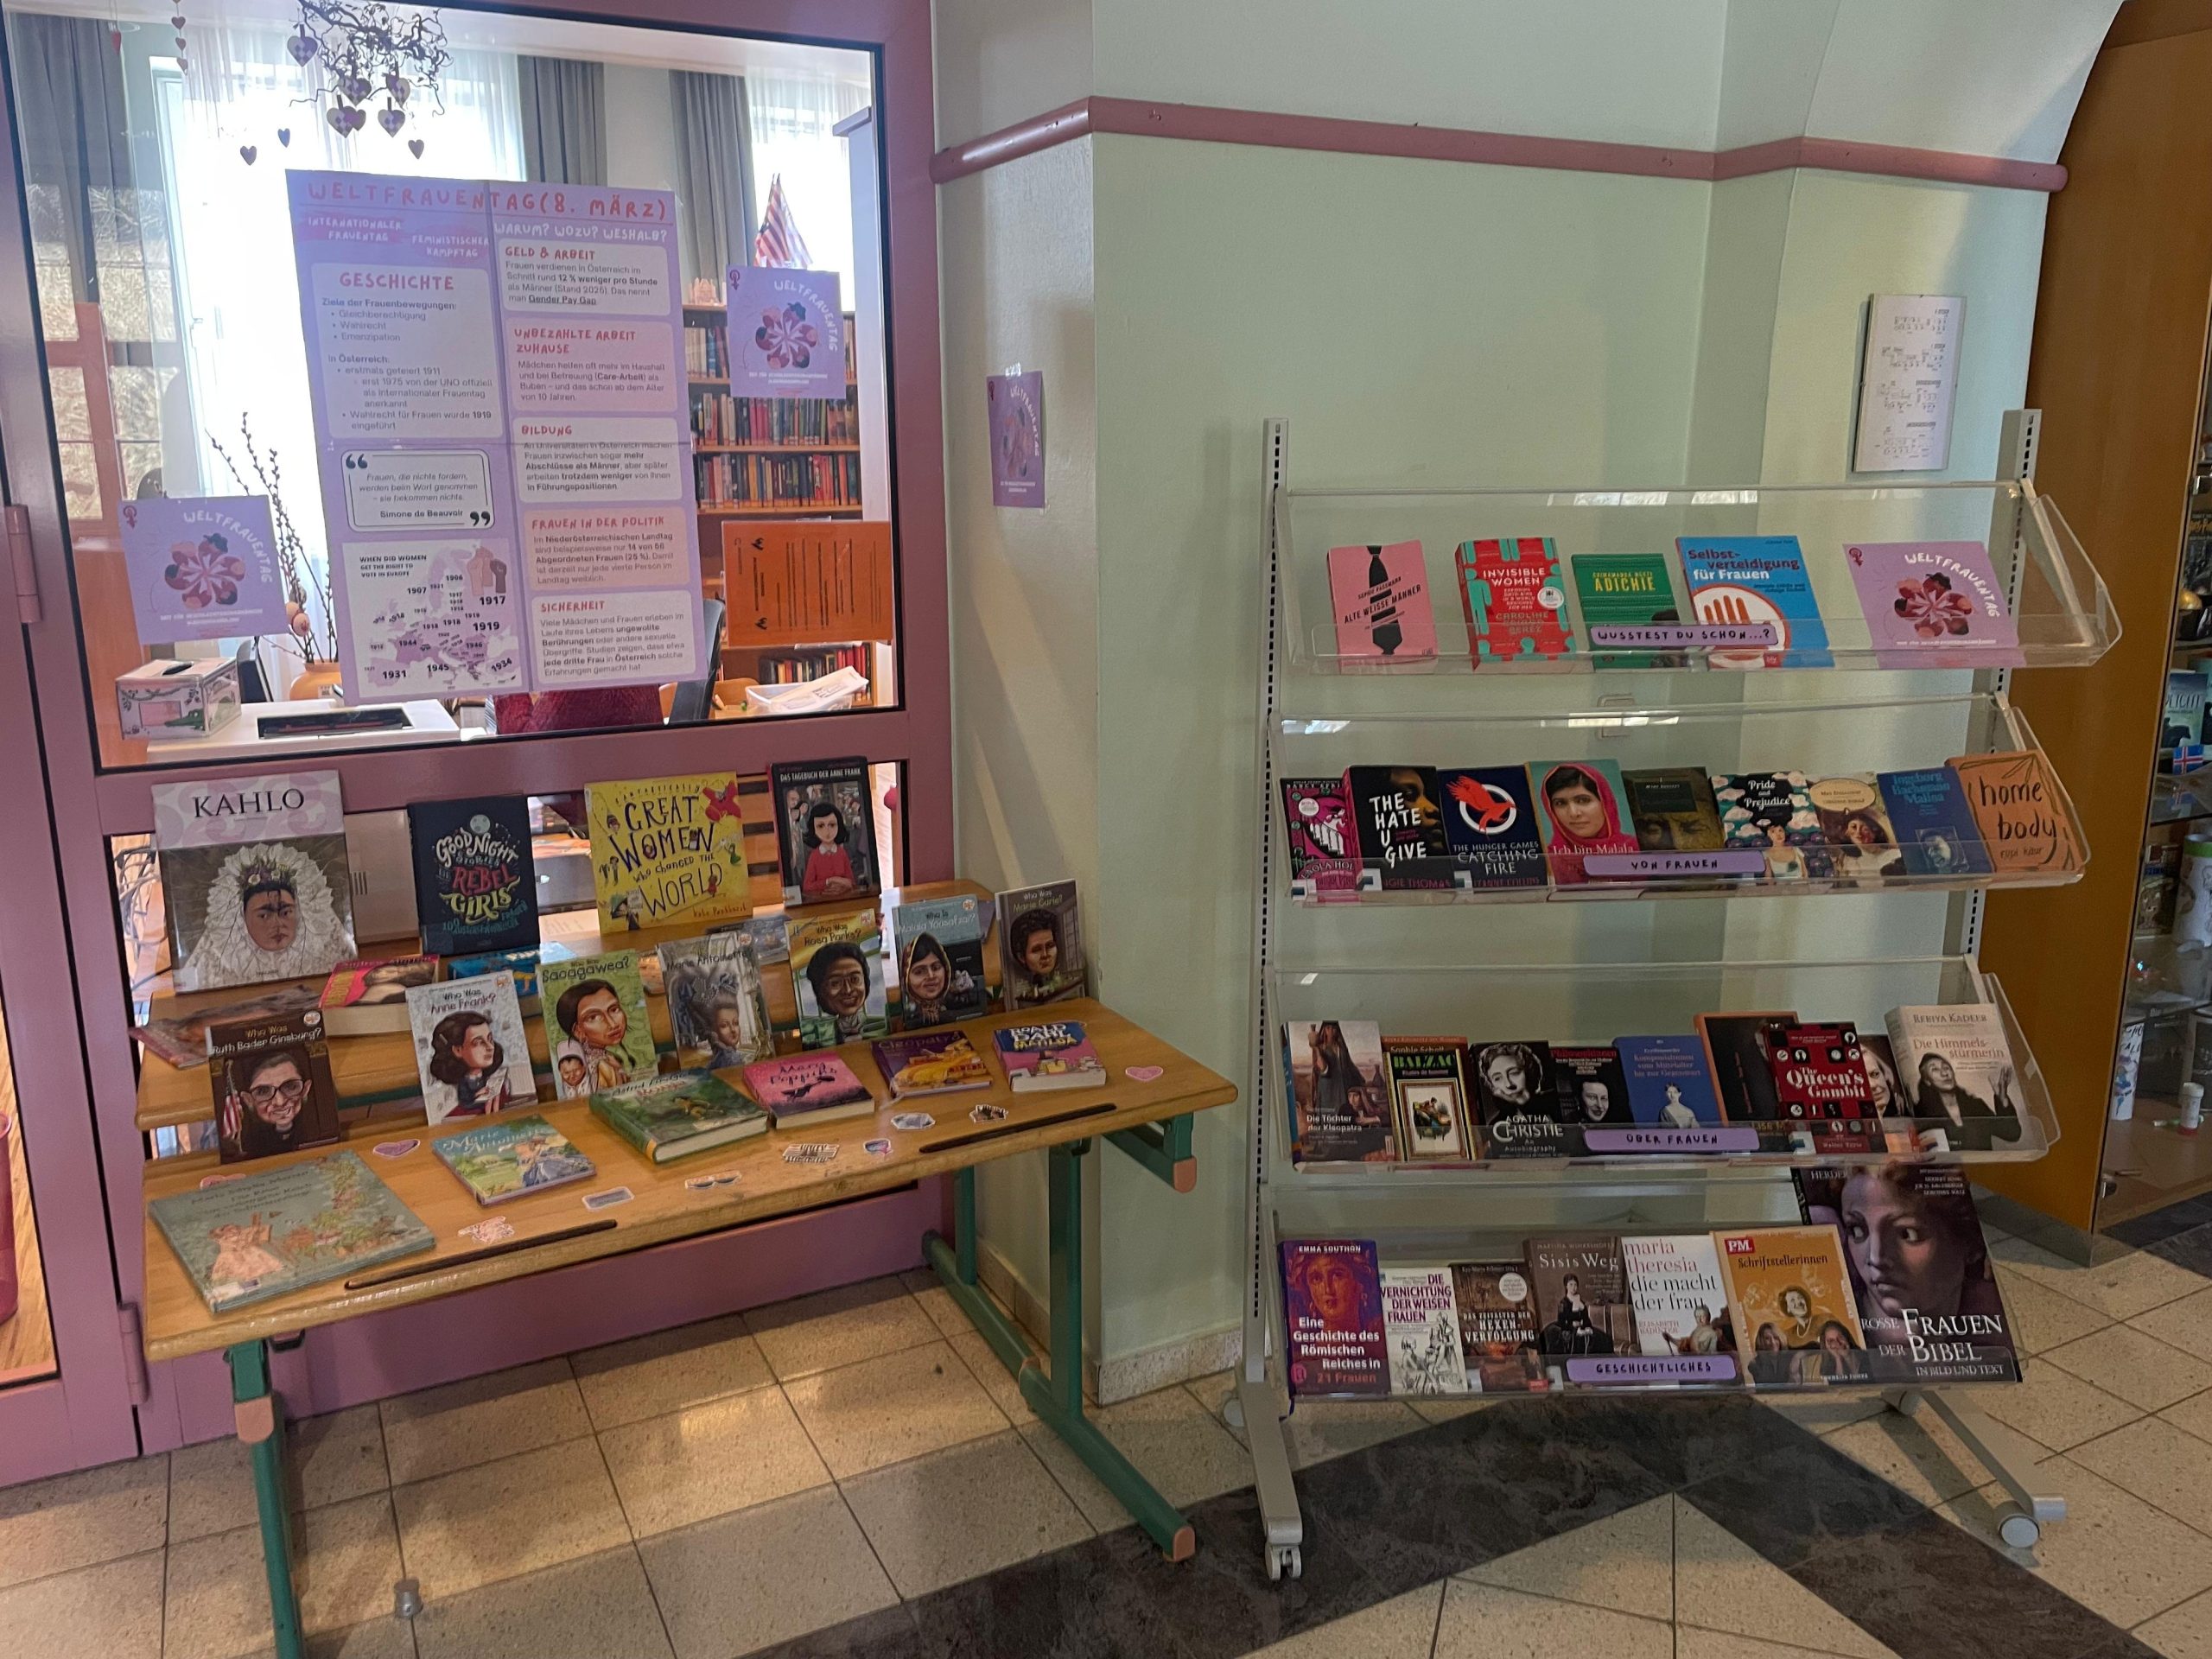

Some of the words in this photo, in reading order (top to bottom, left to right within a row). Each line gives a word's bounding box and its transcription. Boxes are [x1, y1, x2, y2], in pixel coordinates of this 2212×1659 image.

[589, 194, 666, 221] MÄRZ)
[308, 216, 402, 230] INTERNATIONALER
[328, 230, 389, 242] FRAUENTAG
[494, 222, 549, 237] WARUM?
[555, 226, 598, 238] WOZU?
[604, 228, 667, 242] WESHALB?
[412, 234, 490, 246] FEMINISTISCHER
[426, 246, 479, 257] KAMPFTAG
[505, 246, 535, 257] GELD
[540, 246, 549, 258] &
[554, 250, 595, 260] ARBEIT
[339, 271, 454, 290] GESCHICHTE
[578, 276, 611, 285] weniger
[613, 277, 627, 286] pro
[629, 277, 658, 286] Stunde
[347, 298, 363, 307] der
[365, 299, 457, 311] Frauenbewegungen:
[774, 279, 839, 352] WELTFRAUENTAG
[514, 327, 591, 340] UNBEZAHLTE
[595, 330, 636, 341] ARBEIT
[517, 344, 570, 354] ZUHAUSE
[521, 424, 573, 436] BILDUNG
[380, 510, 412, 518] Simone
[414, 510, 425, 518] de
[427, 509, 463, 518] Beauvoir
[532, 518, 576, 530] FRAUEN
[581, 518, 592, 529] IN
[596, 518, 617, 528] DER
[622, 516, 664, 528] POLITIK
[183, 512, 273, 583] WELTFRAUENTAG
[1688, 549, 1740, 560] Selbst-
[1707, 557, 1801, 571] verteidigung
[1483, 567, 1546, 578] INVISIBLE
[1693, 569, 1715, 581] für
[1719, 569, 1770, 581] Frauen
[1491, 576, 1540, 588] WOMEN
[1594, 577, 1656, 592] ADICHIE
[1904, 552, 2000, 619] WELTFRAUENTAG
[480, 595, 506, 606] 1917
[541, 601, 605, 613] SICHERHEIT
[1344, 610, 1362, 624] ALTE
[1363, 599, 1389, 616] WEISSE
[473, 621, 500, 632] 1919
[1598, 631, 1669, 640] WUSSTEST
[1676, 631, 1694, 639] DU
[427, 664, 449, 672] 1945
[491, 658, 512, 673] 1934
[382, 670, 407, 680] 1931
[780, 773, 791, 783] DAS
[791, 770, 818, 781] TAGEBUCH
[818, 769, 830, 779] DER
[830, 768, 843, 778] ANNE
[844, 766, 861, 777] FRANK
[1748, 779, 1776, 790] Pride
[1979, 775, 2043, 807] home
[192, 788, 305, 819] KAHLO
[1369, 791, 1405, 813] THE
[1744, 797, 1791, 810] Prejudice
[624, 795, 699, 831] GREAT
[1375, 807, 1421, 831] HATE
[1998, 809, 2058, 850] body
[1380, 829, 1391, 849] U
[607, 822, 715, 873] WOMEN
[1452, 843, 1470, 852] THE
[1471, 842, 1506, 852] HUNGER
[1510, 841, 1539, 849] GAMES
[1553, 845, 1572, 855] Ich
[1573, 843, 1592, 855] bin
[1595, 842, 1634, 854] Malala
[699, 853, 715, 862] THE
[1385, 841, 1427, 869] GIVE
[1457, 848, 1539, 863] CATCHING
[1484, 861, 1516, 875] FIRE
[1631, 860, 1658, 871] VON
[1666, 859, 1718, 870] FRAUEN
[452, 863, 518, 896] REBEL
[638, 862, 723, 918] WORLD
[899, 922, 927, 934] Malala
[804, 937, 828, 946] Rosa
[830, 928, 862, 943] Parks?
[542, 955, 629, 983] Sacagawea?
[431, 1001, 456, 1014] Anne
[458, 993, 496, 1011] Frank?
[1913, 1014, 1947, 1024] REBIYA
[1948, 1013, 1986, 1023] KADEER
[245, 1027, 267, 1039] Who
[269, 1024, 288, 1035] Was
[1009, 1022, 1067, 1038] ROALD
[213, 1043, 235, 1055] Ruth
[237, 1038, 268, 1051] Bader
[270, 1027, 321, 1046] Ginsburg?
[1014, 1031, 1071, 1044] DAHL
[1014, 1037, 1077, 1051] MATILDA
[1913, 1039, 1932, 1050] Die
[1393, 1054, 1454, 1069] BALZAC
[1786, 1068, 1865, 1090] Queen's
[1808, 1085, 1866, 1099] Gambit
[1322, 1113, 1352, 1122] Töchter
[1506, 1114, 1549, 1123] AGATHA
[1307, 1123, 1321, 1132] der
[1323, 1123, 1363, 1135] Kleopatra
[1492, 1121, 1564, 1142] CHRISTIE
[1668, 1134, 1718, 1145] FRAUEN
[1624, 1238, 1675, 1256] maria
[1539, 1253, 1580, 1268] Sisis
[1582, 1252, 1618, 1271] Weg
[1627, 1256, 1697, 1274] theresia
[1738, 1254, 1828, 1271] Schriftstellerinnen
[1427, 1274, 1444, 1285] DIE
[1630, 1273, 1658, 1292] die
[1664, 1273, 1717, 1291] macht
[1381, 1286, 1452, 1298] VERNICHTUNG
[1391, 1298, 1412, 1310] DER
[1413, 1298, 1451, 1310] WEISEN
[1634, 1293, 1664, 1311] der
[1669, 1293, 1705, 1309] frau
[1299, 1318, 1325, 1329] Eine
[1387, 1311, 1427, 1323] FRAUEN
[1861, 1317, 1900, 1331] ROSSE
[1902, 1308, 2003, 1337] FRAUEN
[1478, 1319, 1522, 1331] HEXEN-
[1294, 1330, 1357, 1343] Geschichte
[1359, 1330, 1380, 1341] des
[1465, 1329, 1535, 1342] VERFOLGUNG
[1300, 1343, 1365, 1356] Römischen
[1878, 1344, 1906, 1357] DER
[1909, 1335, 1982, 1363] BIBEL
[1322, 1358, 1367, 1370] Reiches
[1369, 1357, 1381, 1369] in
[1596, 1362, 1712, 1374] GESCHICHTLICHES
[1929, 1366, 1952, 1376] BILD
[1953, 1365, 1978, 1376] UND
[1980, 1363, 2004, 1375] TEXT
[1317, 1372, 1330, 1383] 21
[1335, 1372, 1376, 1383] Frauen
